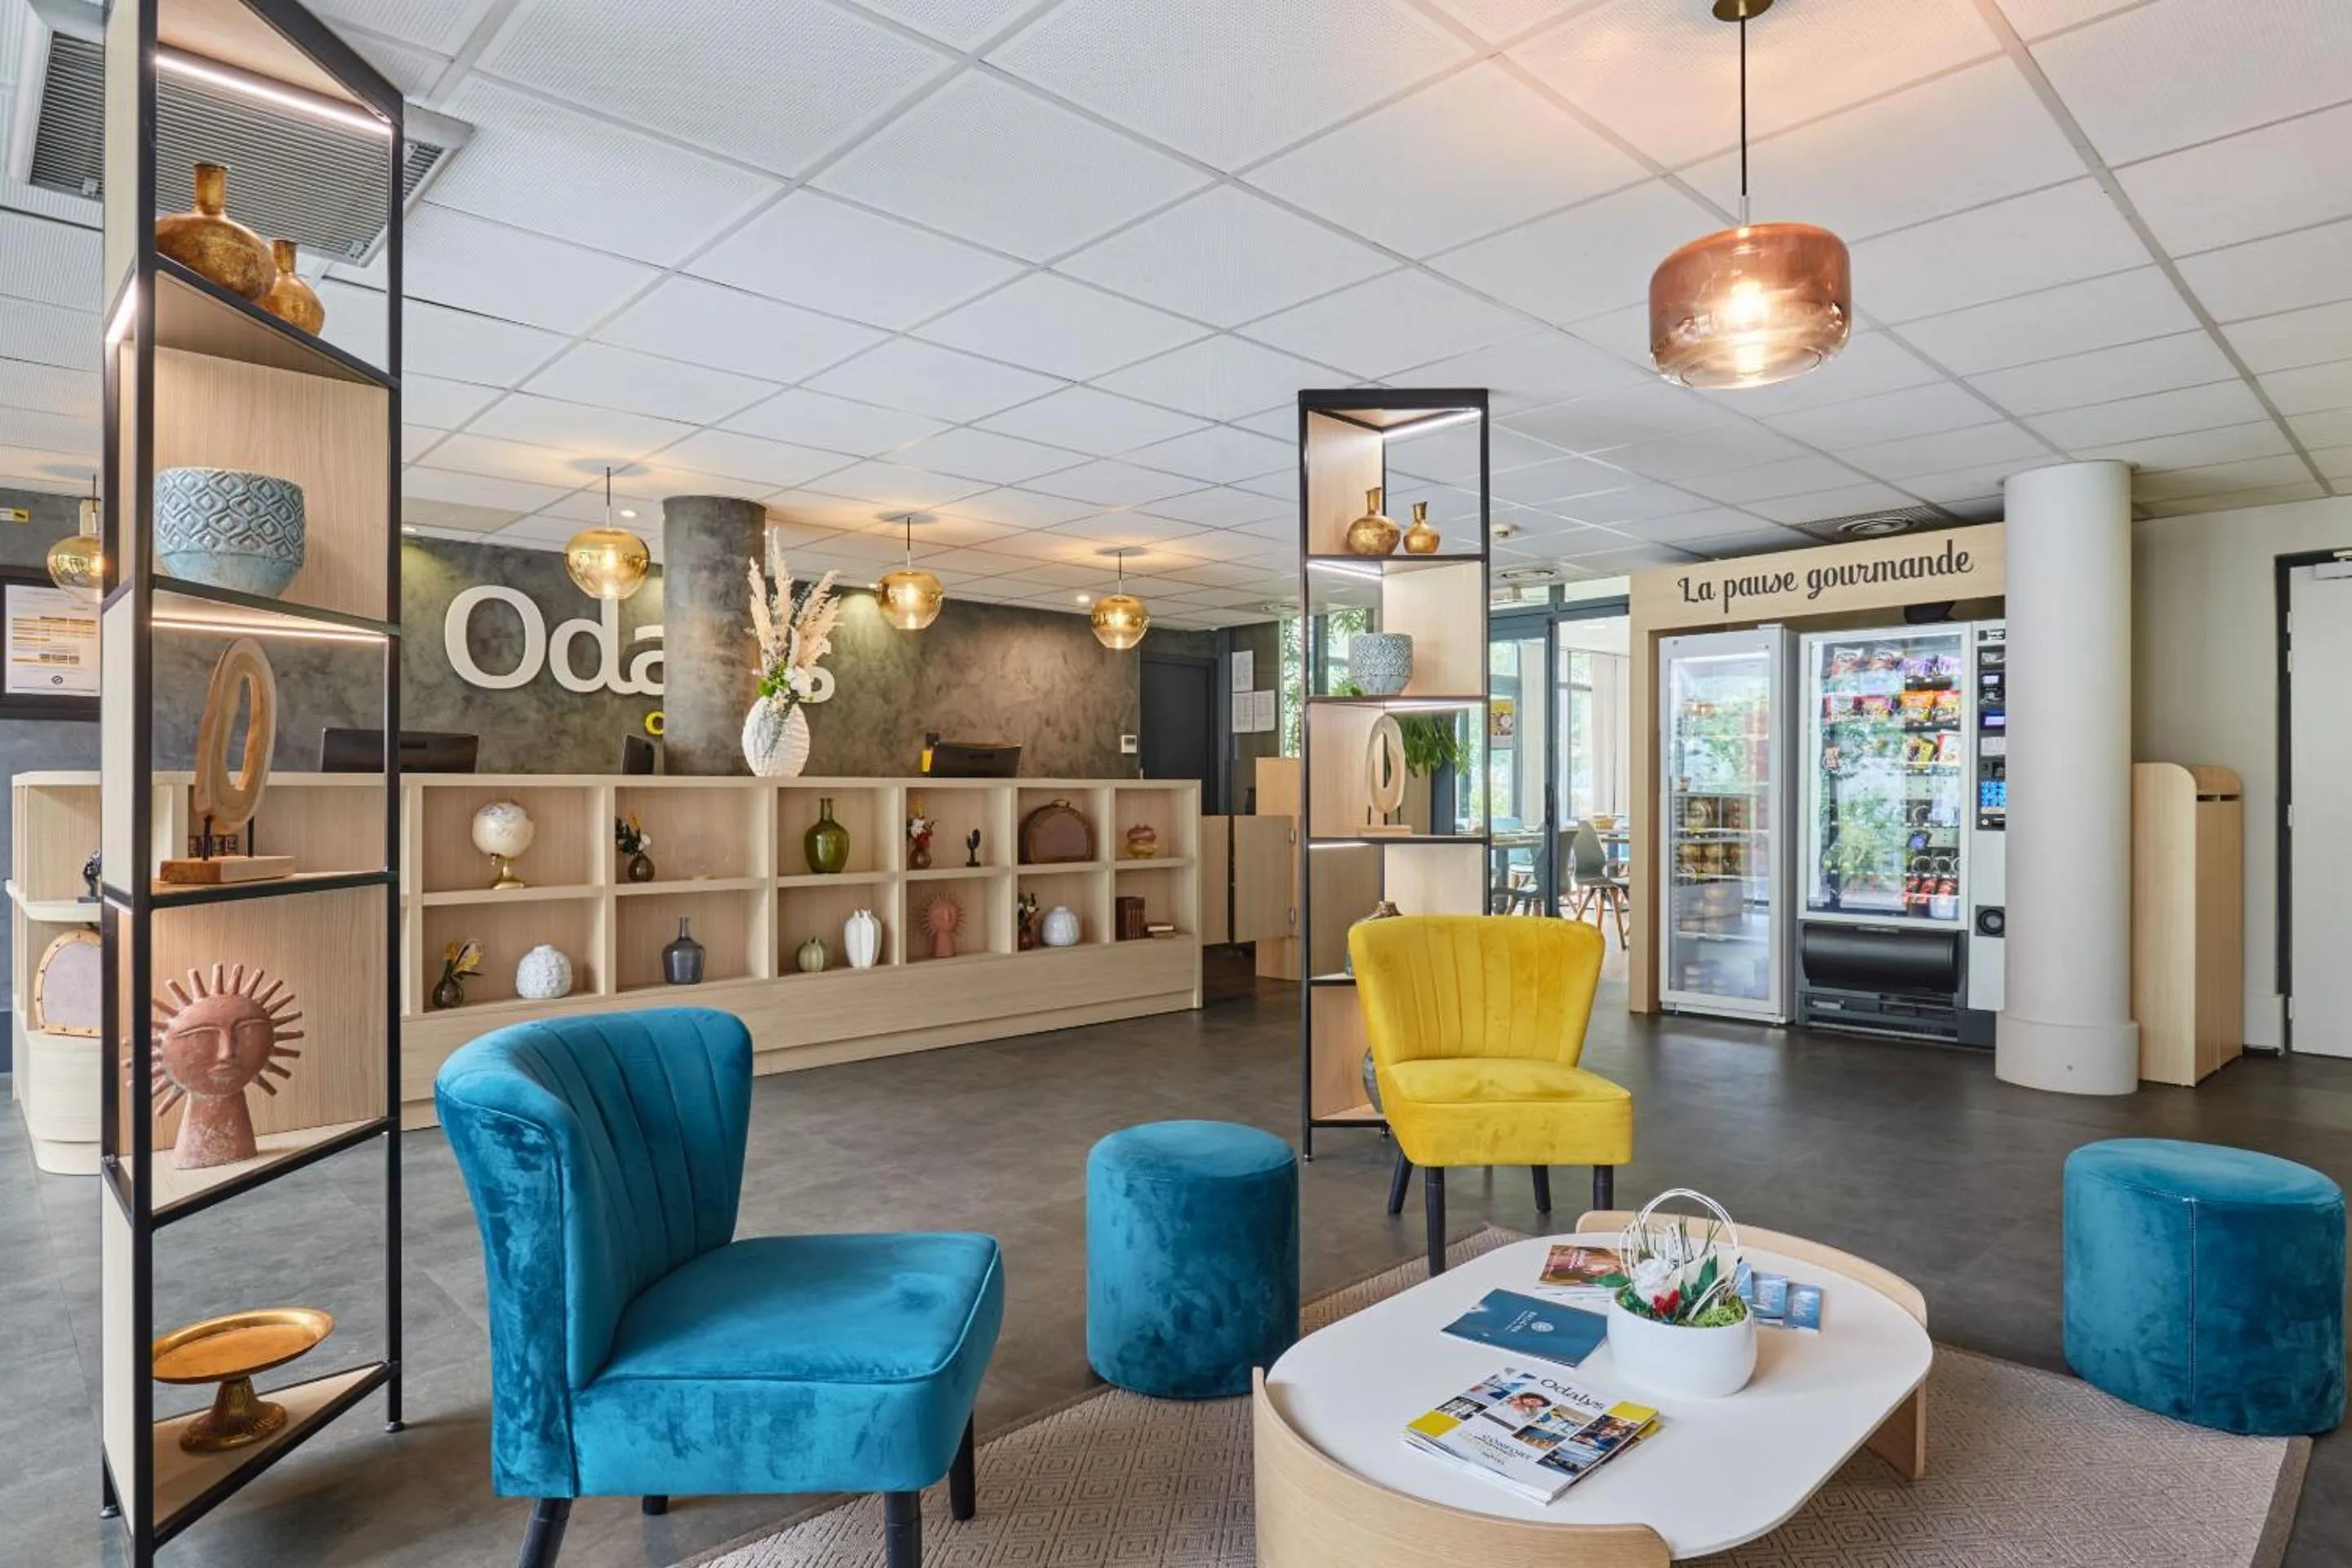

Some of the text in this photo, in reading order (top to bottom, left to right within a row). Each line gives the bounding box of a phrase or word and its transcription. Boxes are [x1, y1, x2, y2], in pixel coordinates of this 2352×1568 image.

[1677, 539, 1973, 613] La pause gourmande
[444, 584, 835, 703] Oda
[1540, 1379, 1606, 1410] Odalys
